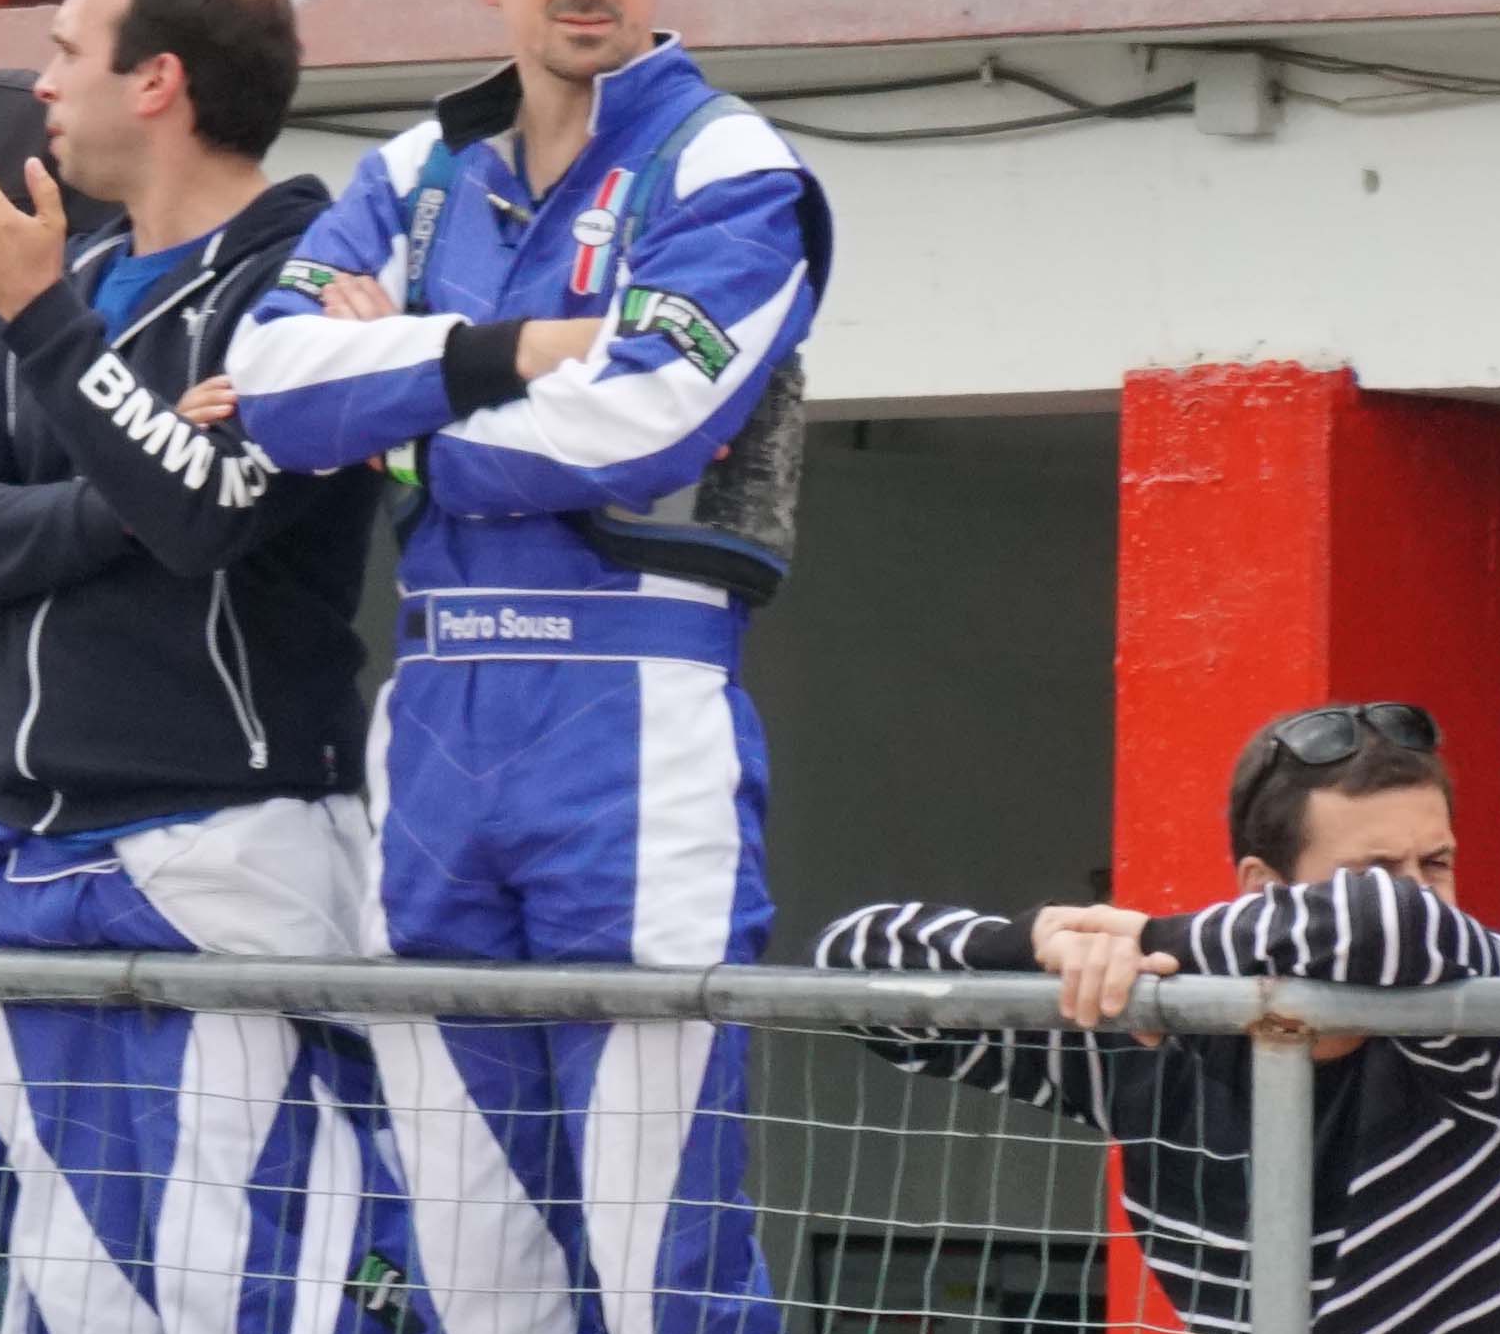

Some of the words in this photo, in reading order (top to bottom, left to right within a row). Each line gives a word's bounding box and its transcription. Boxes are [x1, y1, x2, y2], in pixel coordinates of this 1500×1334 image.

[77, 351, 216, 490] BMW
[438, 608, 496, 640] Pedro
[500, 608, 574, 640] Sousa
